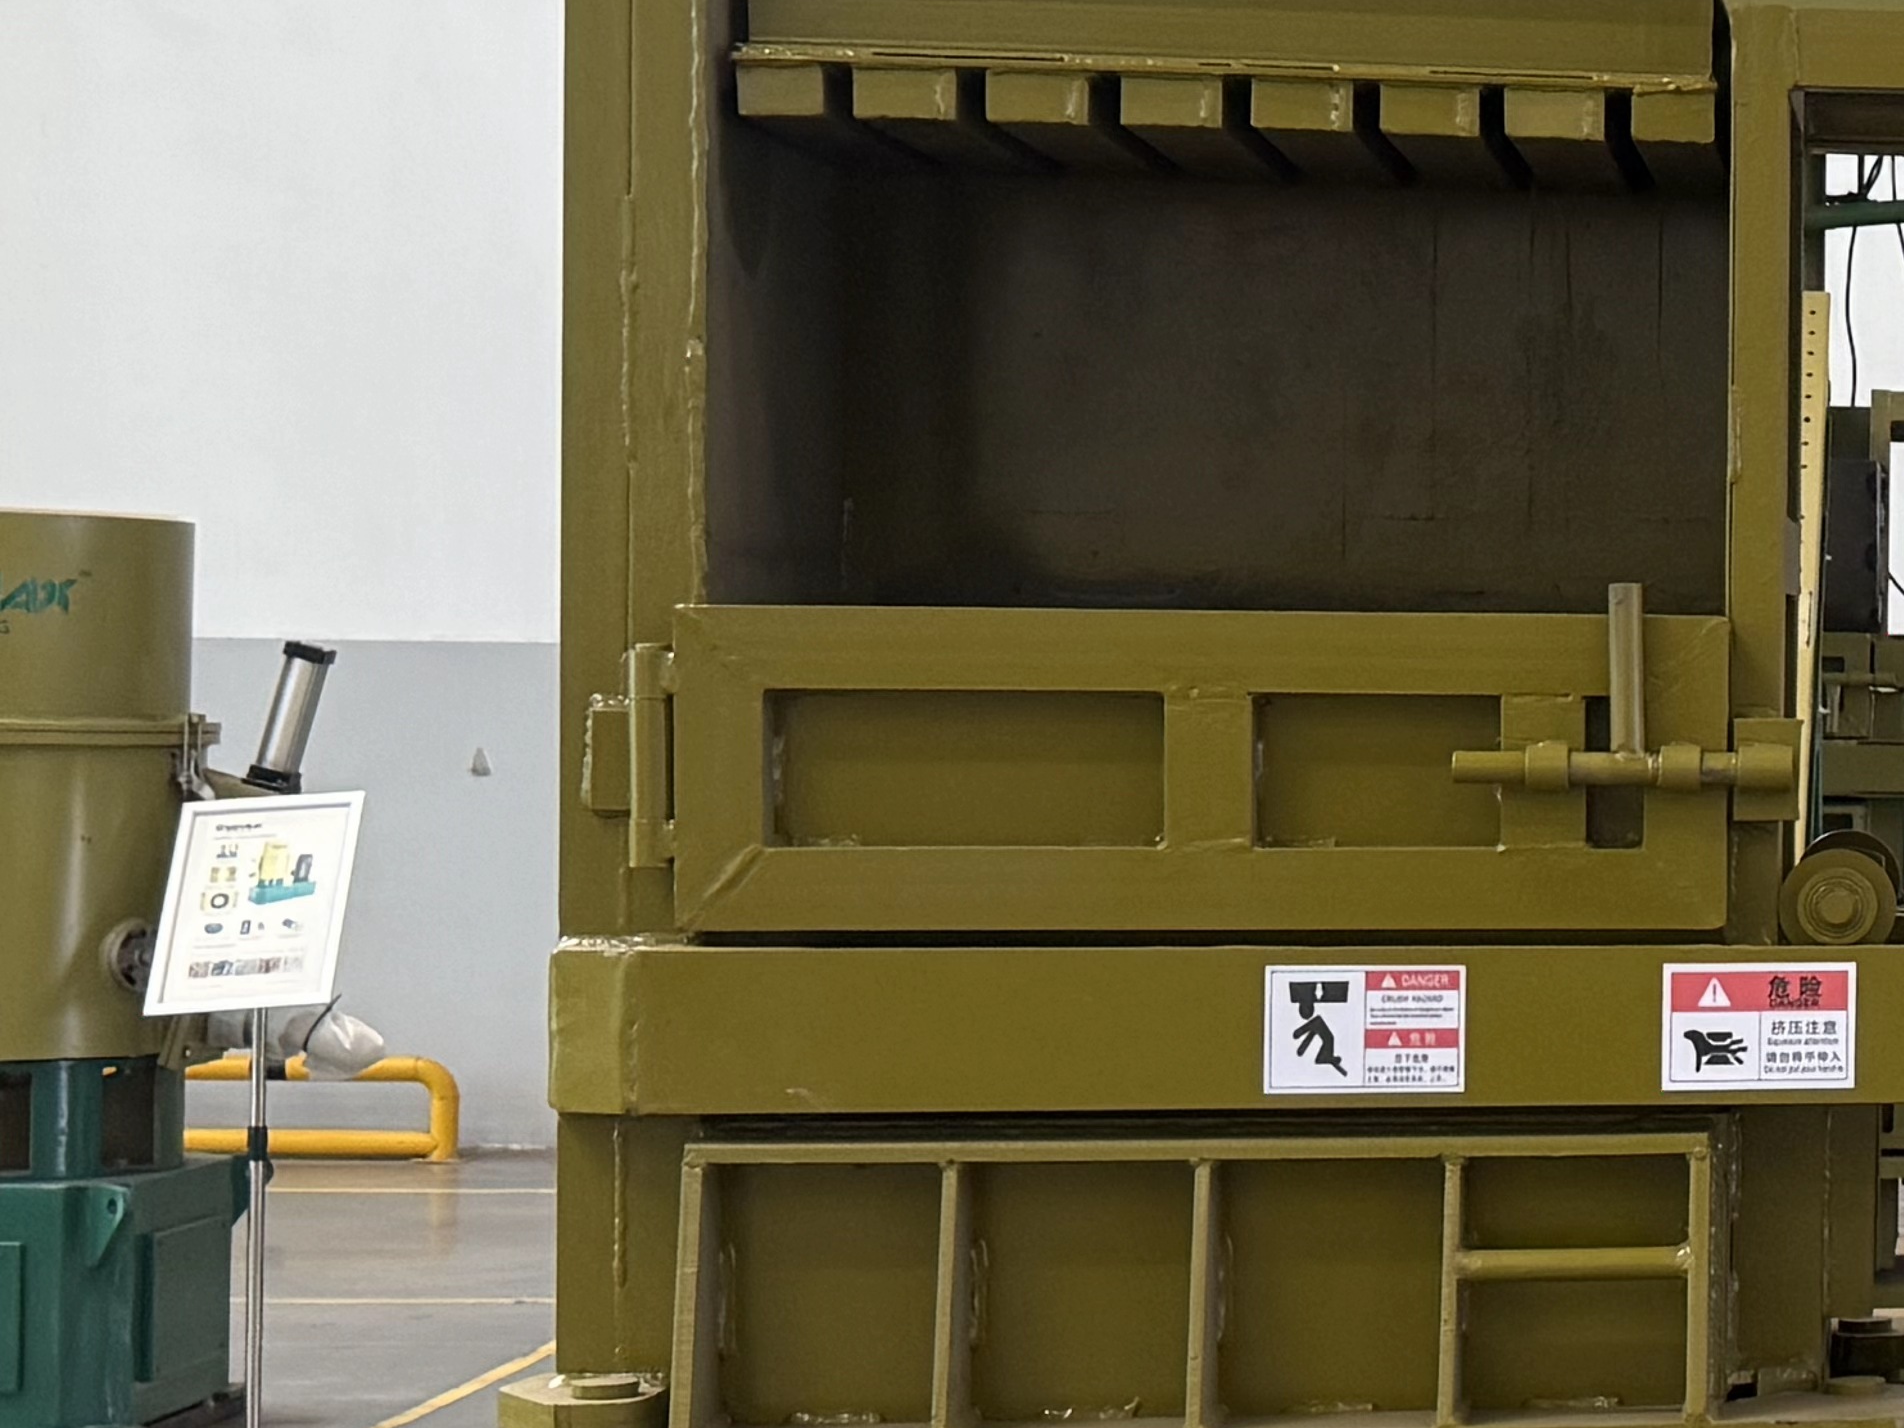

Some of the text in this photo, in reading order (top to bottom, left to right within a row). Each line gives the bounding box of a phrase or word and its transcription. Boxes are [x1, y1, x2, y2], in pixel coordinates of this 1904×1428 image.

[1401, 973, 1449, 988] DANGER
[1768, 975, 1824, 997] 危险
[1769, 998, 1819, 1009] DANGER
[1771, 1020, 1837, 1035] 挤压注意
